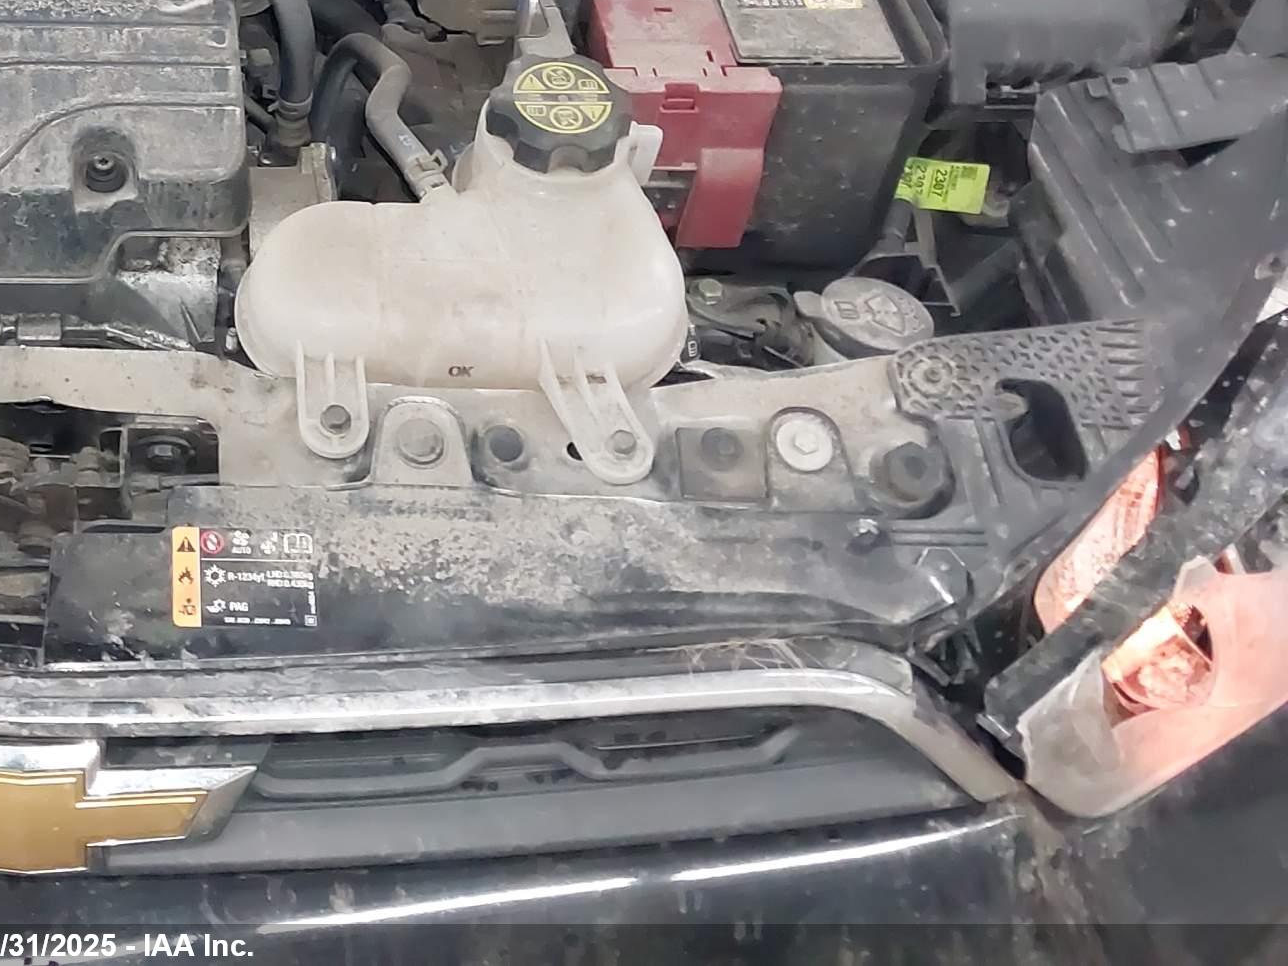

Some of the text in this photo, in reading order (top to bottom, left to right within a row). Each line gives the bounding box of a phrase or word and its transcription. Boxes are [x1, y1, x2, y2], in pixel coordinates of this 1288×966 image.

[931, 169, 948, 197] 2307
[448, 365, 475, 378] OK
[229, 601, 249, 612] PAG
